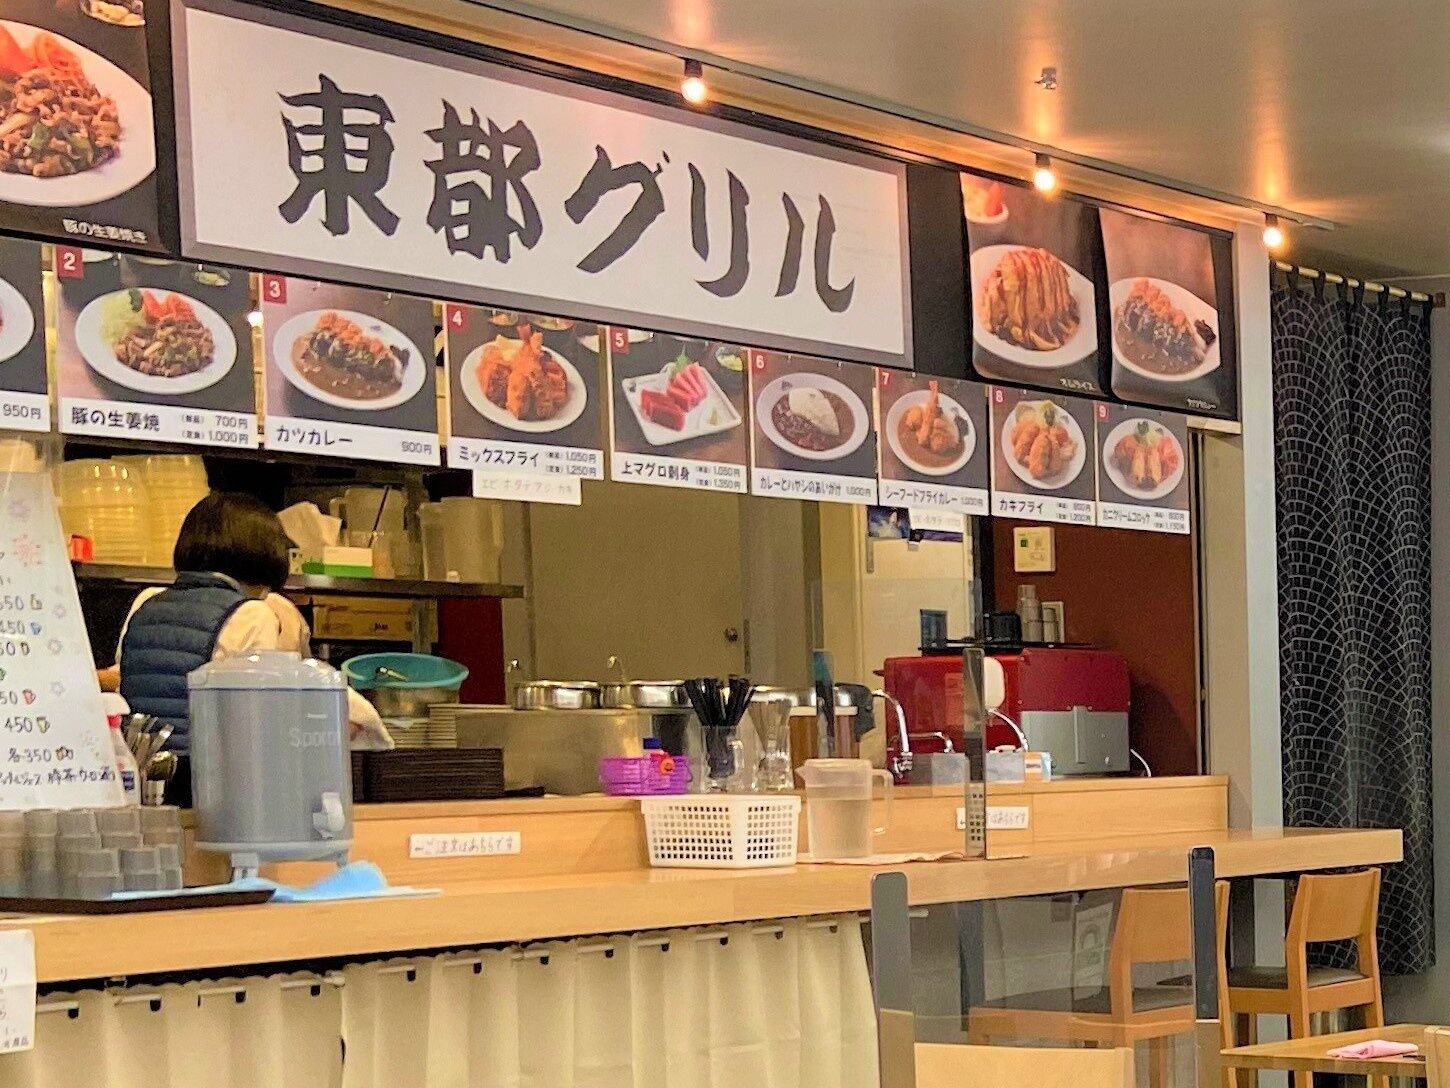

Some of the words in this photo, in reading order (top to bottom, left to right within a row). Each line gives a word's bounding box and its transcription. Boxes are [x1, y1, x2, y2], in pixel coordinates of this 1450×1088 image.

[278, 73, 857, 314] 東都グリル
[63, 252, 76, 271] 2
[269, 279, 281, 298] 3
[452, 309, 463, 327] 4
[615, 333, 624, 347] 5
[755, 355, 764, 368] 6
[882, 373, 890, 386] 7
[995, 390, 1003, 402] 8
[3, 403, 41, 419] 950円
[71, 406, 160, 432] 豚の生姜焼
[215, 415, 248, 429] 700円
[1099, 406, 1107, 418] 9
[275, 424, 353, 446] カツカレー
[401, 440, 432, 456] 900円
[459, 445, 540, 468] ミックスフライ
[621, 460, 690, 481] 上マグロ刺身
[1000, 500, 1044, 515] カキフライ
[5, 717, 33, 734] 450
